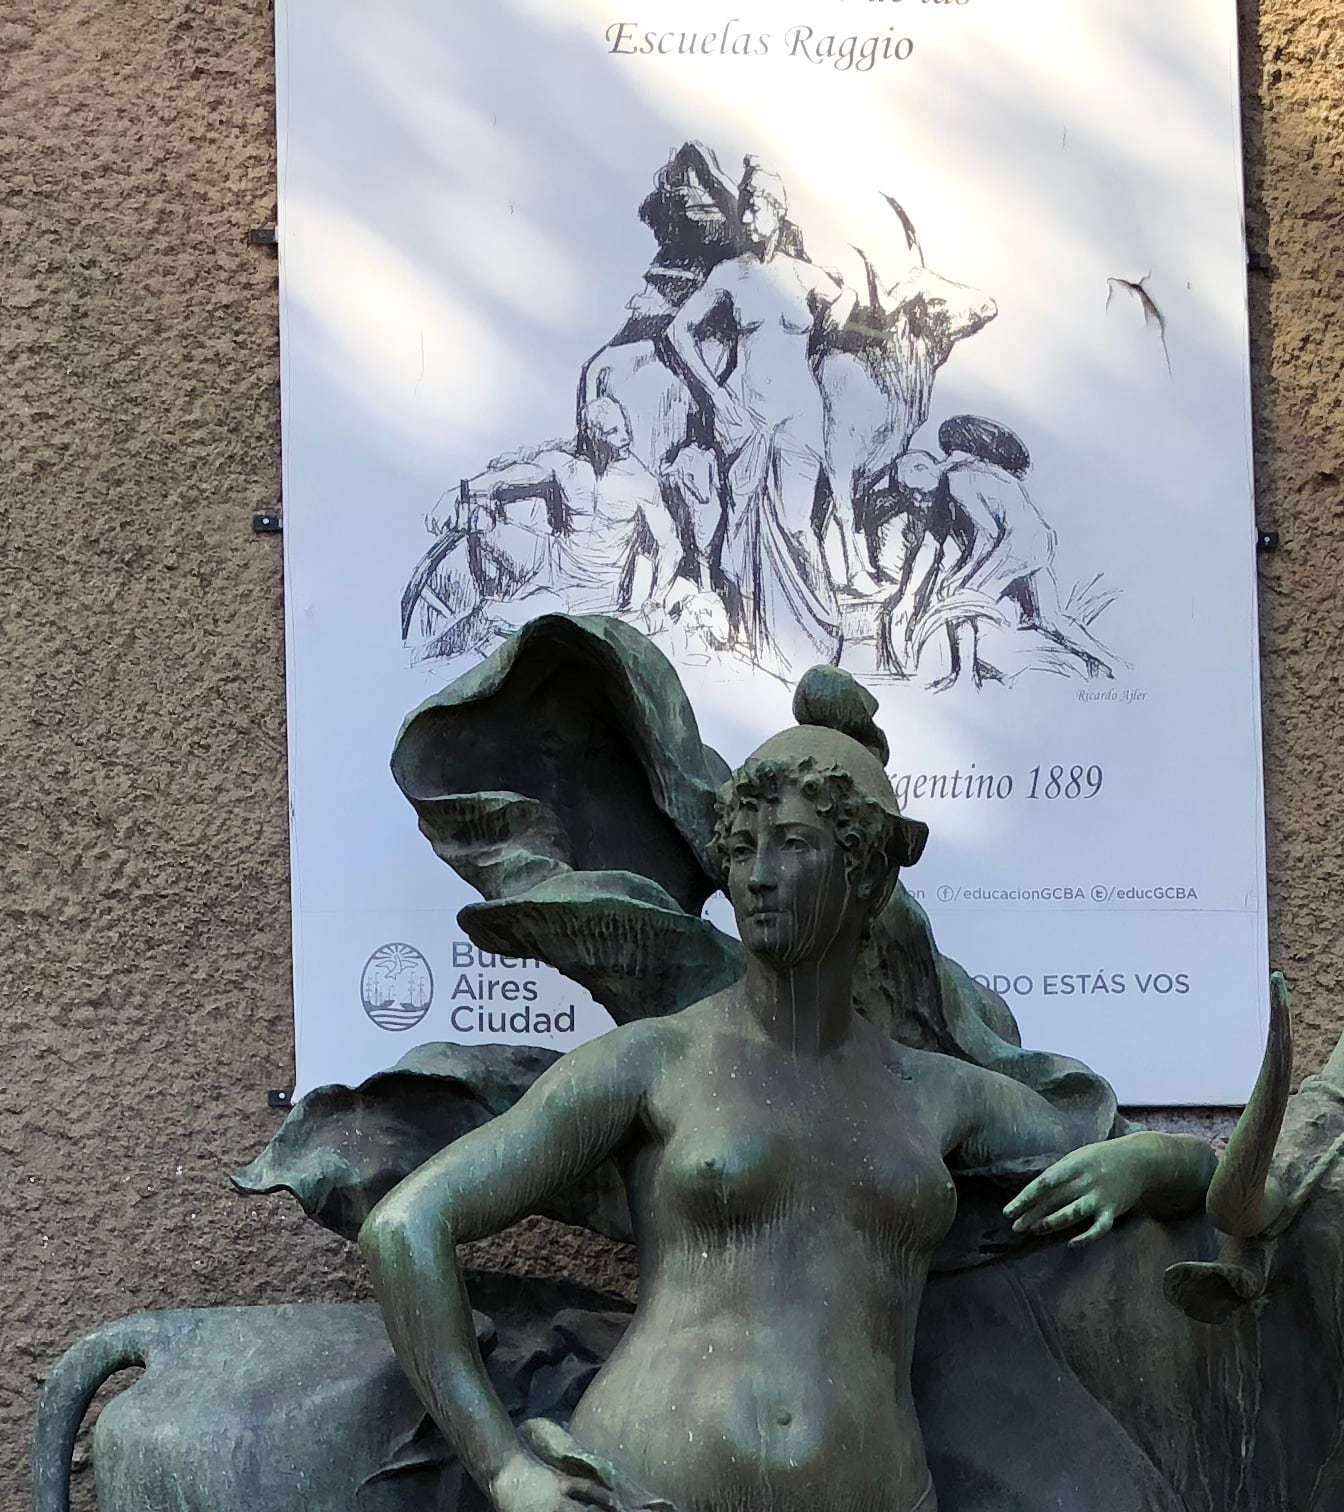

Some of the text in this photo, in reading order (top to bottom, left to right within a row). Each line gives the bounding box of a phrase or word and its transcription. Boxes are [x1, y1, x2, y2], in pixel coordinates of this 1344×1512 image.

[605, 18, 915, 72] Escuelas Raggio
[888, 764, 1104, 810] gentino 1889
[451, 974, 538, 1001] Aires
[974, 969, 1190, 996] ODO ESTÁS VOS
[451, 1005, 575, 1033] Ciudad
